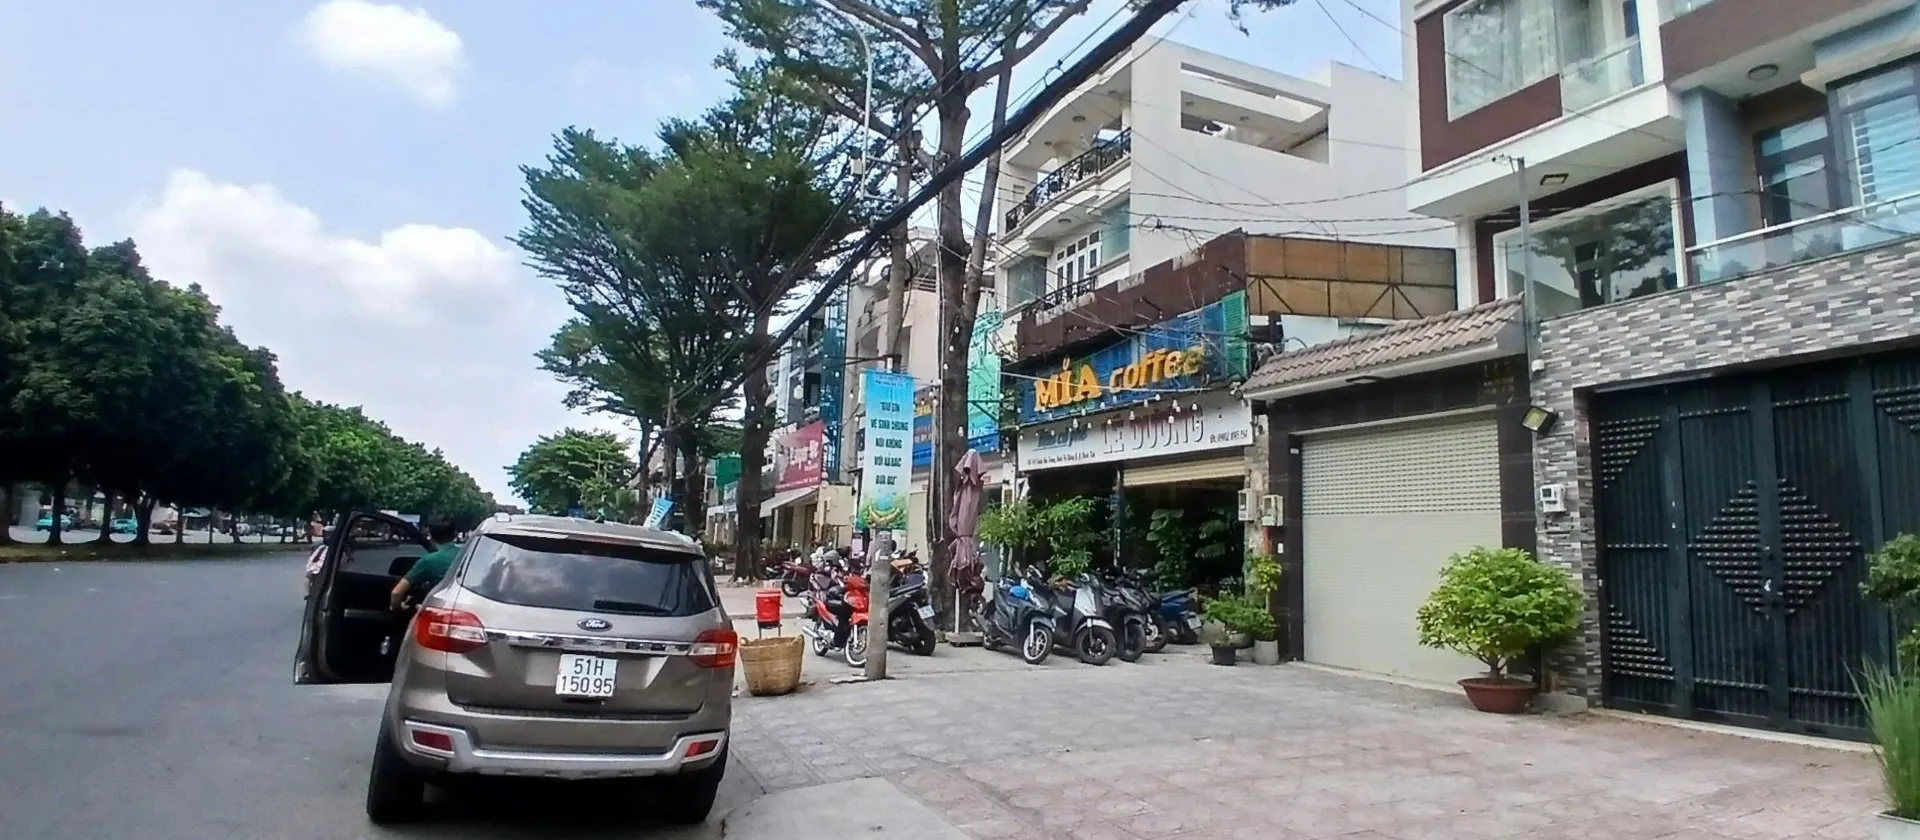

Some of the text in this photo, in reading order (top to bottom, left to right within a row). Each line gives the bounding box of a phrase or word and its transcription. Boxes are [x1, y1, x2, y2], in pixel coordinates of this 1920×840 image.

[1109, 346, 1205, 392] coffee
[585, 619, 606, 628] Ford
[574, 658, 605, 676] 51H
[561, 675, 613, 694] 150.95
